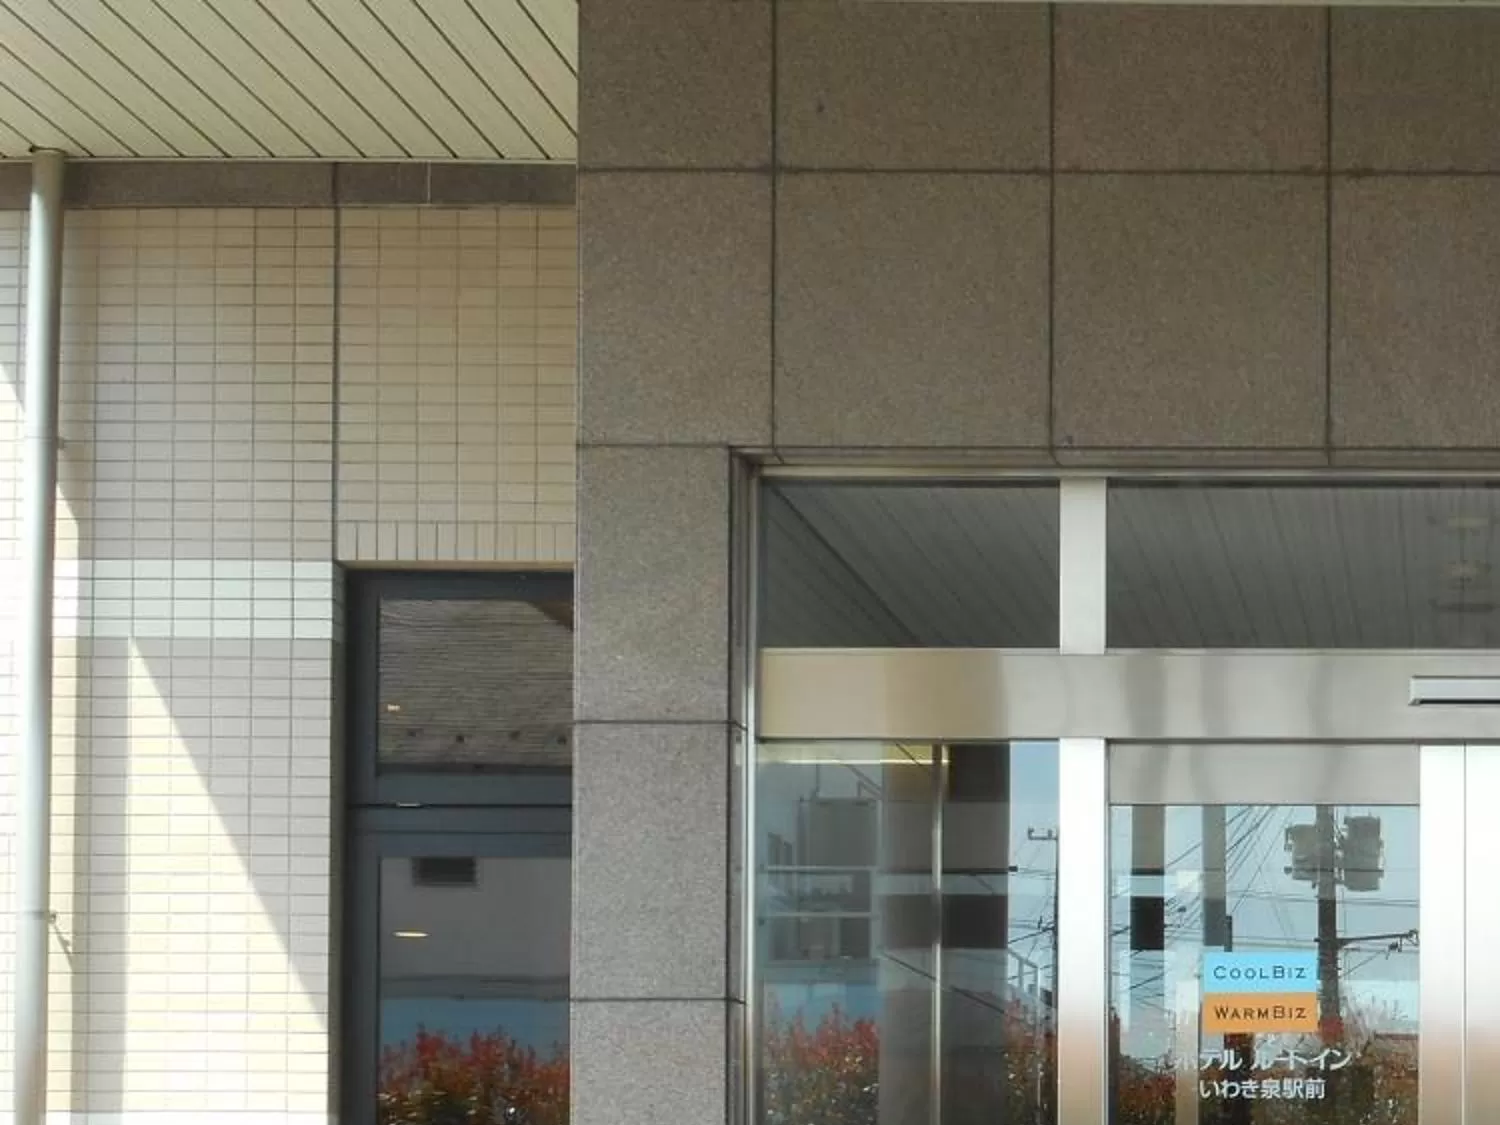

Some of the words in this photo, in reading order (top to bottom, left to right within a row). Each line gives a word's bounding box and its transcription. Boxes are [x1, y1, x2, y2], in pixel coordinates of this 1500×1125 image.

[1200, 1076, 1326, 1100] いわき泉駅前
